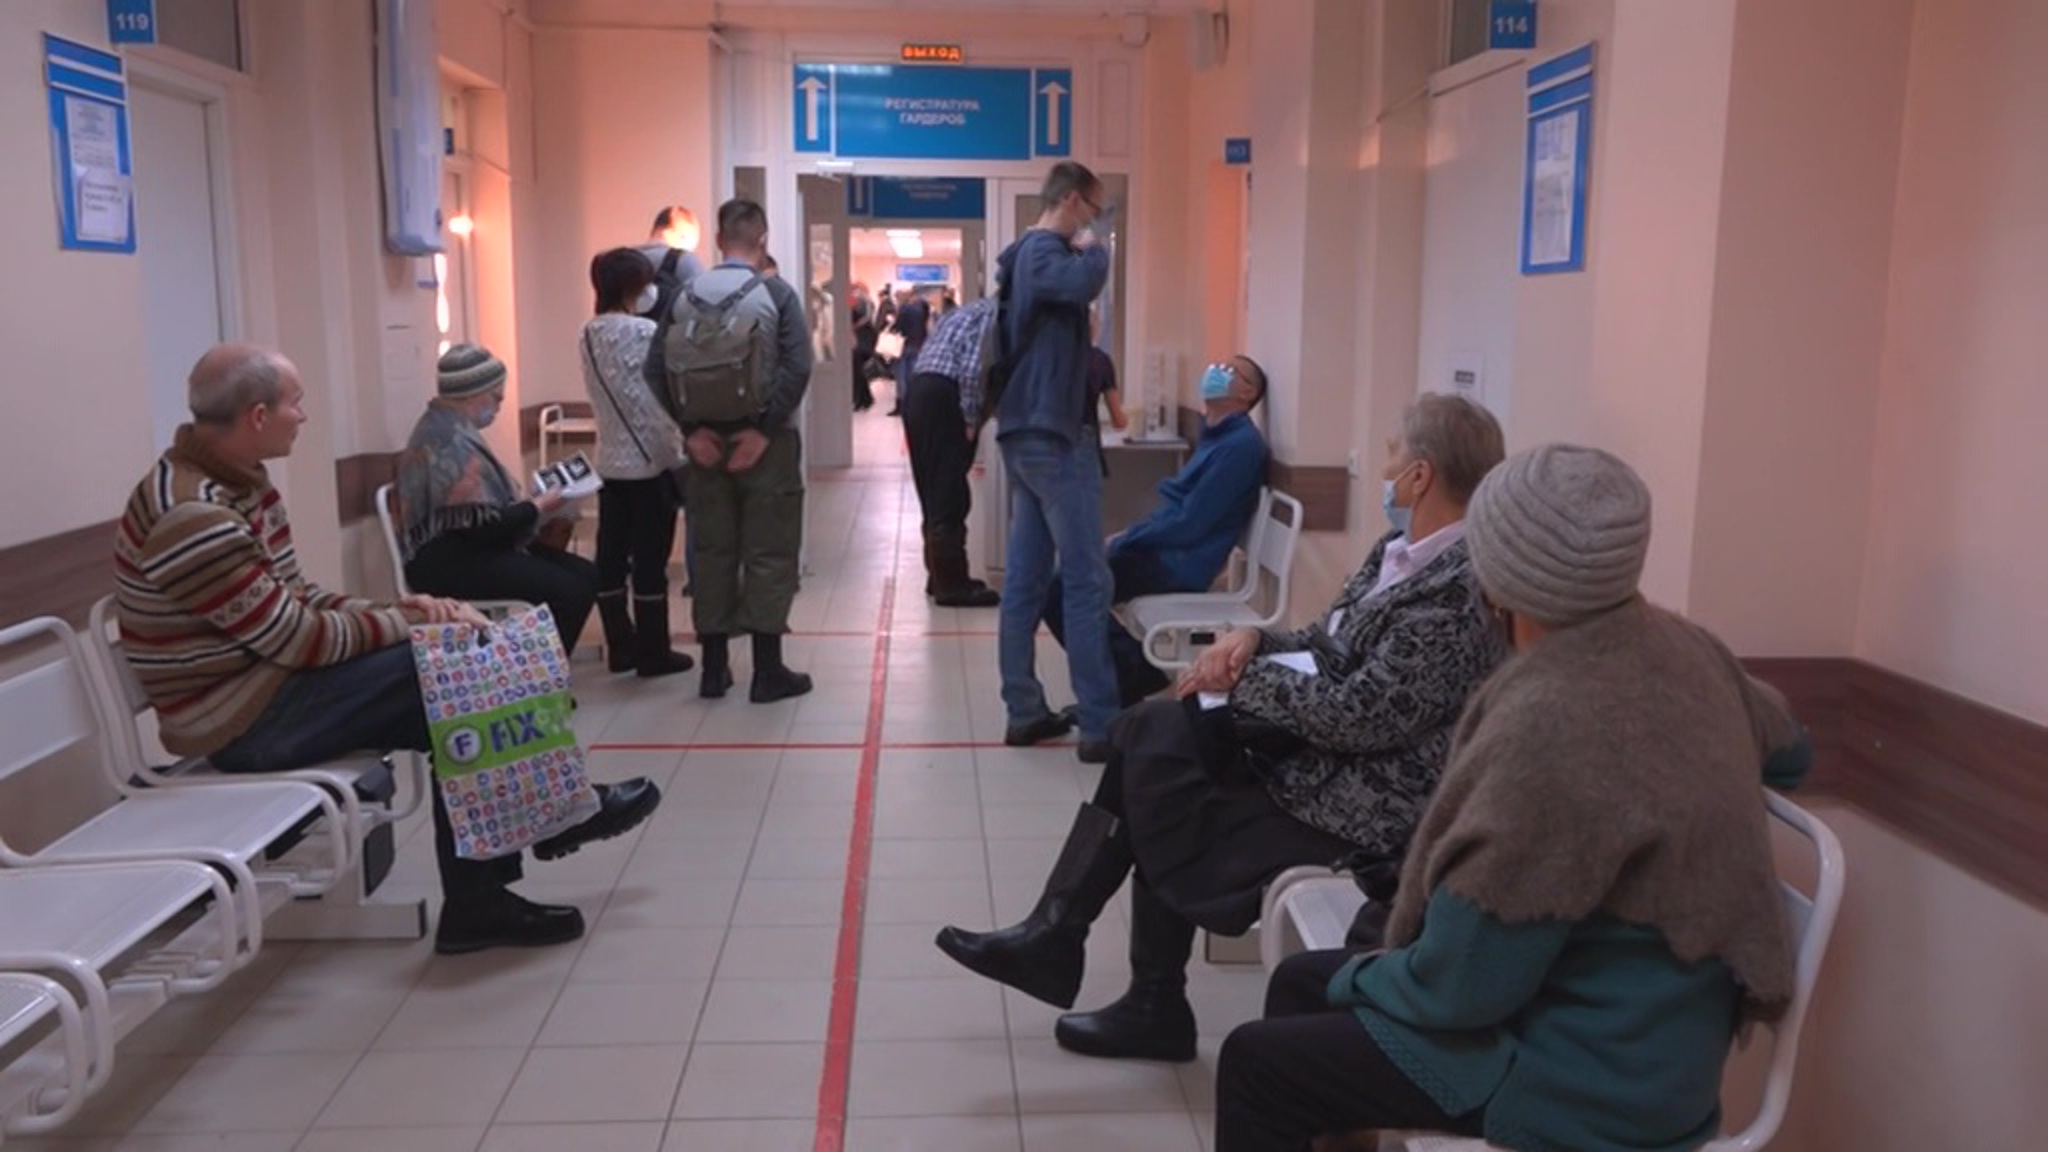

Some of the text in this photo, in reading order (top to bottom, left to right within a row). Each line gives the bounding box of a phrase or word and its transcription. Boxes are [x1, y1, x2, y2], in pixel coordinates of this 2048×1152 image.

[116, 13, 149, 30] 119
[1495, 16, 1528, 33] 114
[903, 47, 959, 60] ВЫХОД
[884, 98, 980, 111] РЕГИСТРАТУРА
[899, 112, 965, 125] ГАРДЕРОБ
[454, 733, 472, 757] F
[489, 711, 545, 753] FIX
